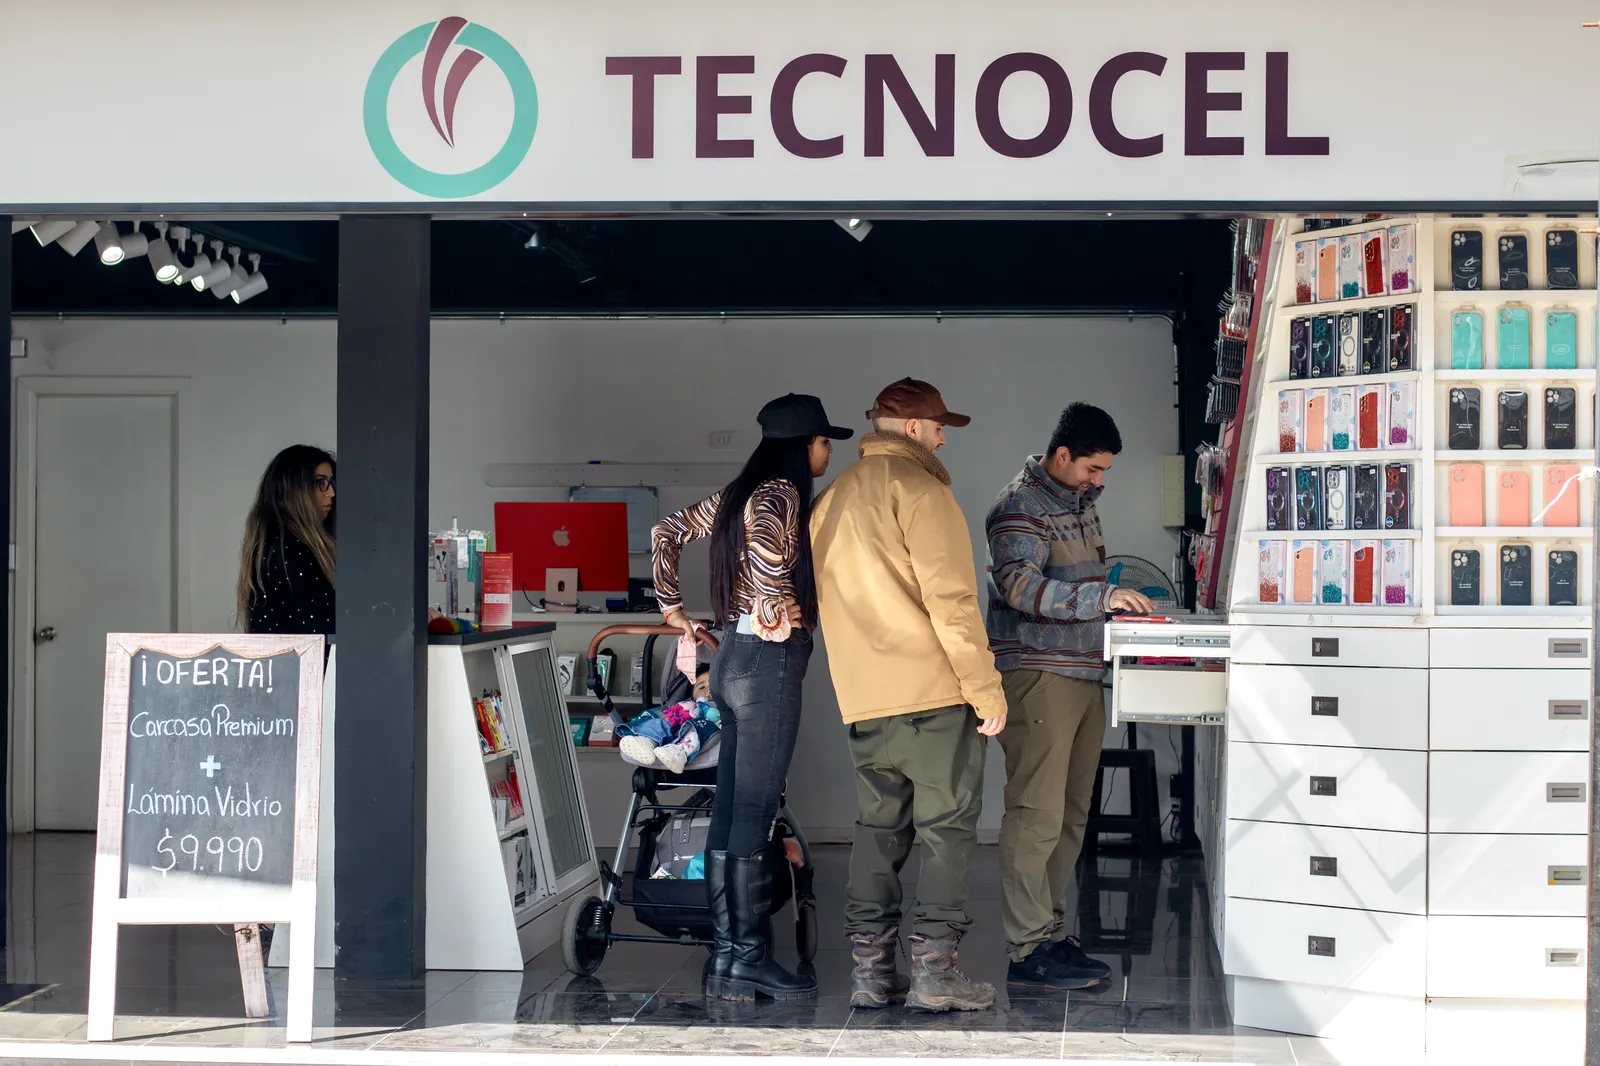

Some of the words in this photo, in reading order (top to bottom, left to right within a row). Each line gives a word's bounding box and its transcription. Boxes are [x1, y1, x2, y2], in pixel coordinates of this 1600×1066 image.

[606, 52, 1330, 159] TECNOCEL
[129, 711, 211, 738] Carcasa
[211, 703, 294, 738] Premium
[199, 755, 222, 778] +
[215, 782, 282, 817] Vidrio
[151, 827, 263, 879] $9.990
